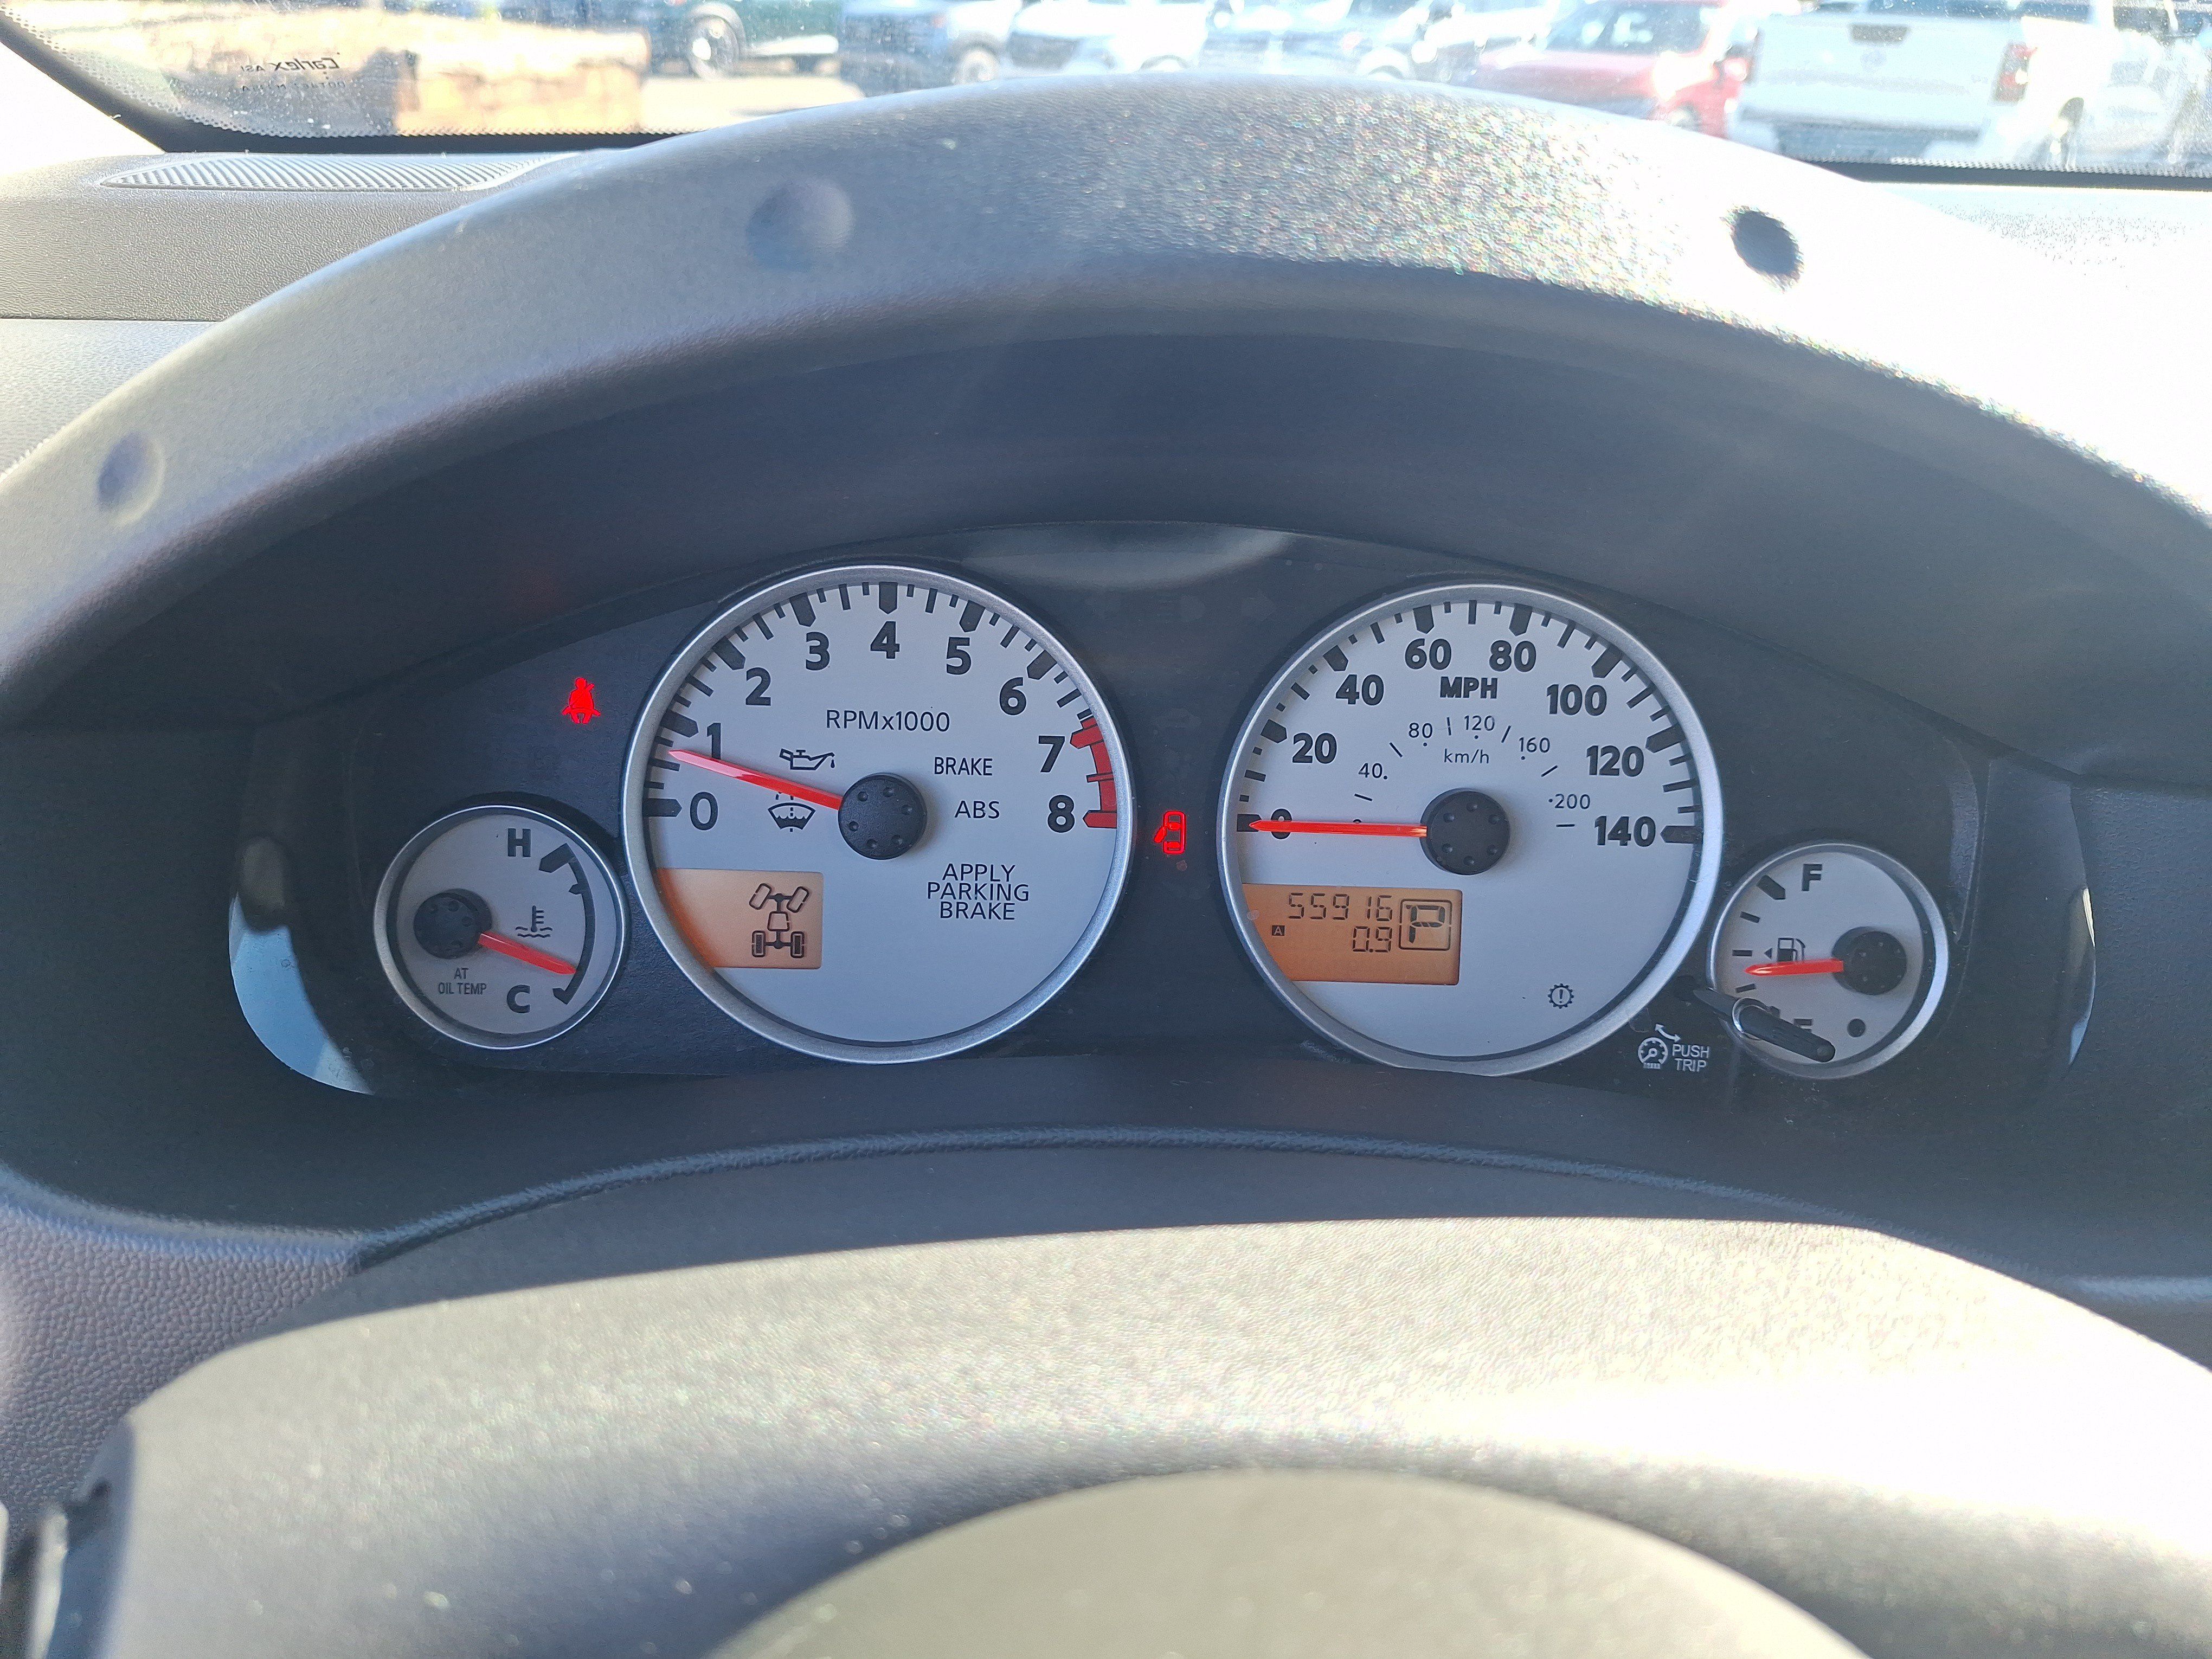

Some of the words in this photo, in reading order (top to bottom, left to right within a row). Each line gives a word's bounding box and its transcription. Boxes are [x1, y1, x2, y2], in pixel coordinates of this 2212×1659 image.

[806, 632, 831, 671] 3
[870, 622, 900, 659] 4
[1405, 639, 1451, 670] 60
[946, 637, 972, 675] 5
[1489, 641, 1536, 672] 80
[745, 668, 771, 706] 2
[999, 677, 1027, 716] 6
[1336, 674, 1384, 705] 40
[1440, 677, 1498, 699] MPH
[1547, 684, 1607, 716] 100
[826, 710, 950, 732] RPMx1000
[1409, 723, 1433, 738] 80
[1464, 716, 1495, 731] 120
[706, 722, 722, 759] 1
[1038, 736, 1065, 773] 7
[1293, 733, 1338, 764] 20
[1519, 737, 1550, 753] 160
[934, 757, 993, 776] BRAKE
[1444, 748, 1489, 764] km/h
[1586, 745, 1644, 777] 120
[1358, 763, 1382, 779] 40
[690, 792, 718, 831] 0
[955, 801, 1000, 819] ABS
[1047, 795, 1075, 833] 8
[1555, 794, 1590, 809] 200
[1270, 808, 1292, 839] 0
[1594, 816, 1656, 847] 140
[508, 828, 531, 857] H
[942, 864, 1015, 882] APPLY
[1802, 864, 1822, 891] F
[928, 882, 1029, 902] PARKING
[940, 902, 1015, 920] BRAKE
[1288, 893, 1392, 921] 55916
[1406, 904, 1445, 943] P
[1352, 926, 1392, 953] 0.9
[454, 968, 468, 979] AT
[438, 982, 454, 994] OIL
[457, 982, 487, 995] TEMP
[506, 985, 530, 1013] C
[1672, 1044, 1709, 1058] PUSH
[1674, 1058, 1707, 1072] TRIP
